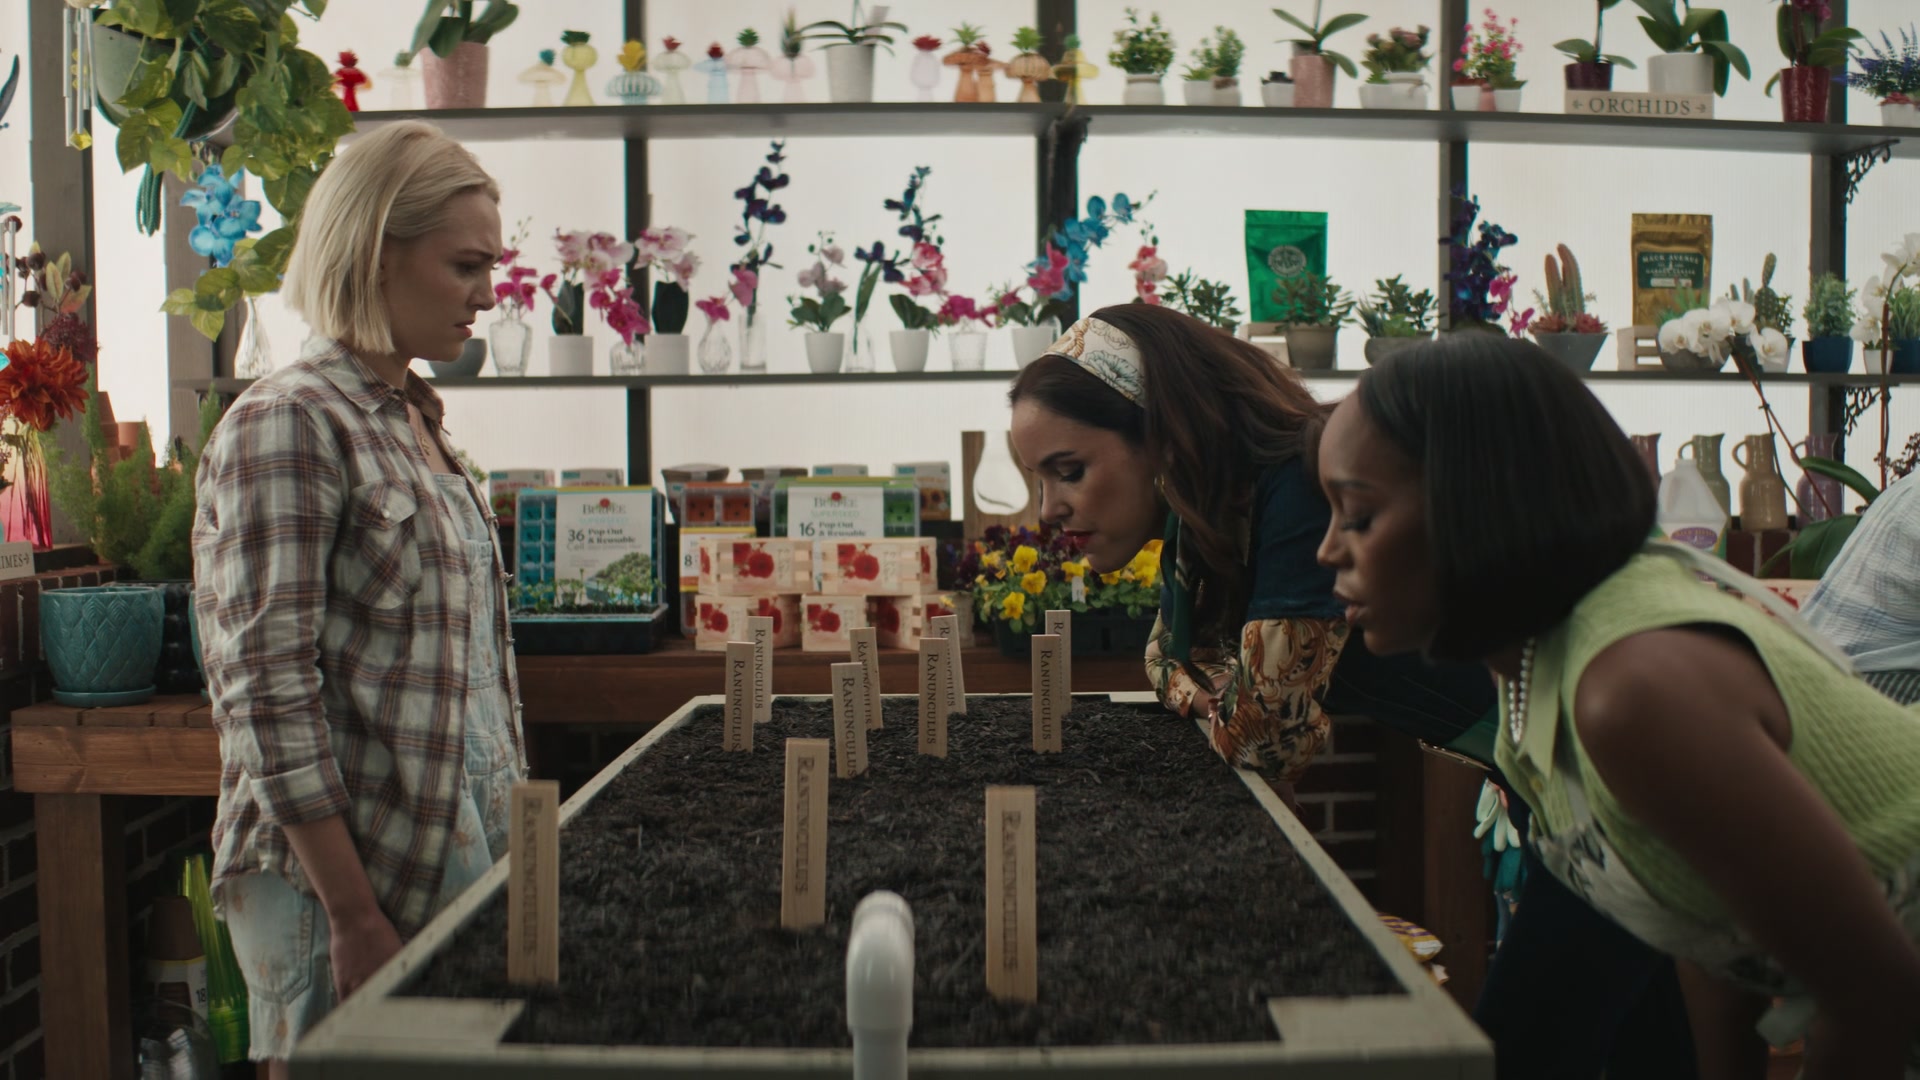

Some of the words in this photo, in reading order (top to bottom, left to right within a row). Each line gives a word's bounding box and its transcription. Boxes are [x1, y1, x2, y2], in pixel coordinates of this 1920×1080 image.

[1588, 97, 1691, 115] ORCHIDS
[568, 529, 585, 542] 36
[607, 527, 623, 535] Out
[799, 521, 816, 537] 16
[0, 553, 24, 569] IMES
[684, 554, 692, 567] 8
[754, 629, 765, 709] RANUNCULUS
[731, 660, 745, 751] RANUNCULUS
[926, 653, 939, 745] RANUNCULUS
[1041, 650, 1052, 740] RANUNCULUS
[842, 677, 858, 778] RANUNCULUS
[795, 757, 815, 895] RANUNCULUS
